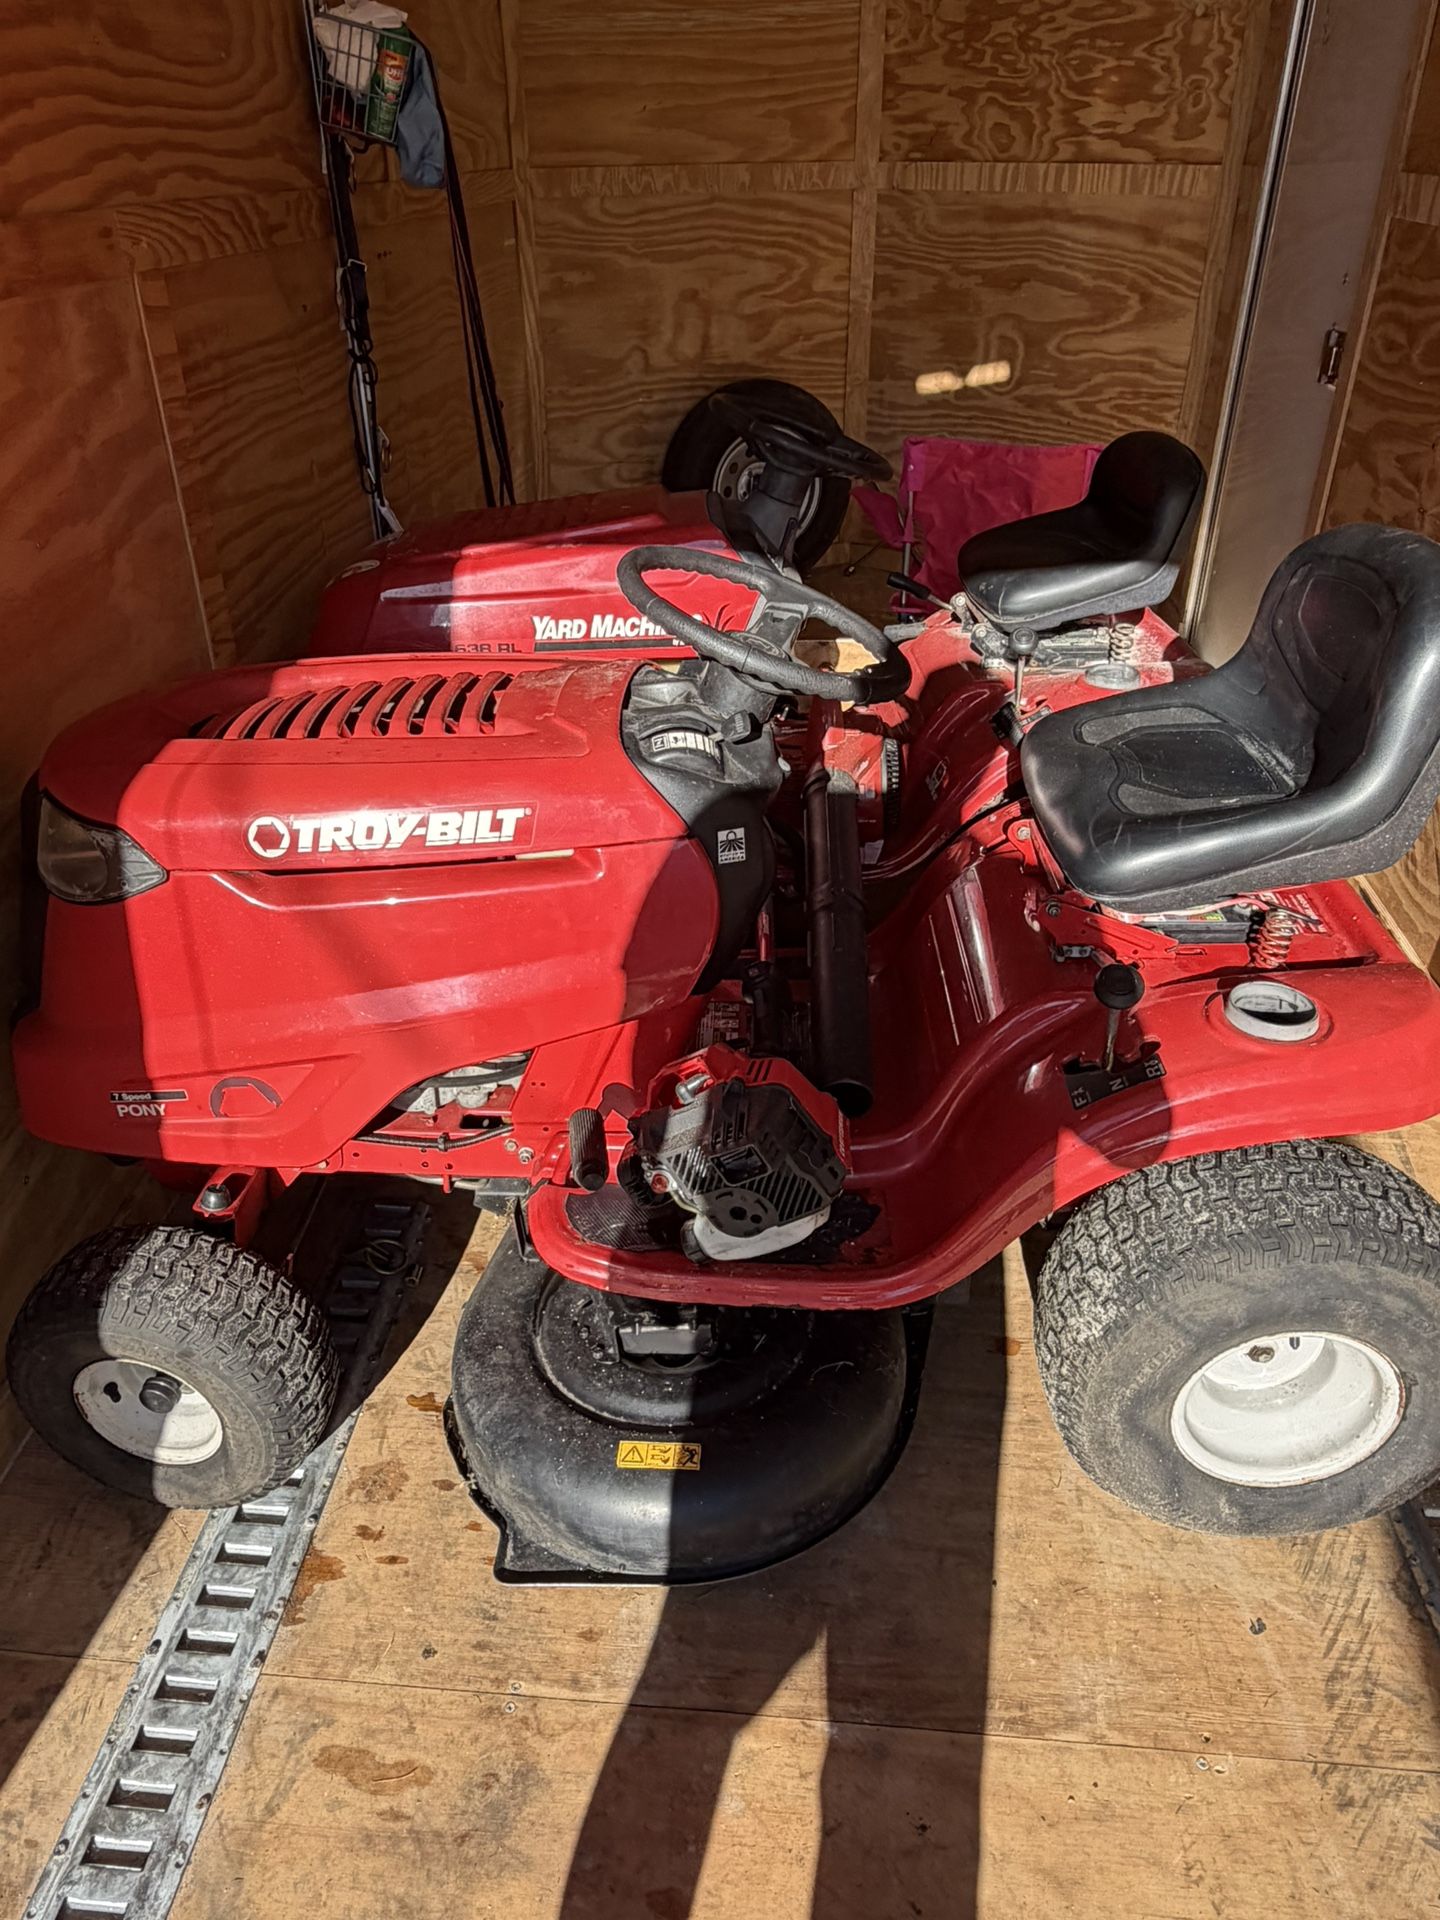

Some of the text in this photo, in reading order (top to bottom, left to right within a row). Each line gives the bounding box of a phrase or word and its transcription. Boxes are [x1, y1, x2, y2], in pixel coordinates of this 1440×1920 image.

[531, 615, 586, 640] YARD
[292, 807, 526, 853] TROY-BILT
[1145, 1066, 1161, 1078] R
[1109, 1078, 1124, 1091] N
[121, 1093, 152, 1101] Speed
[116, 1103, 166, 1117] PONY
